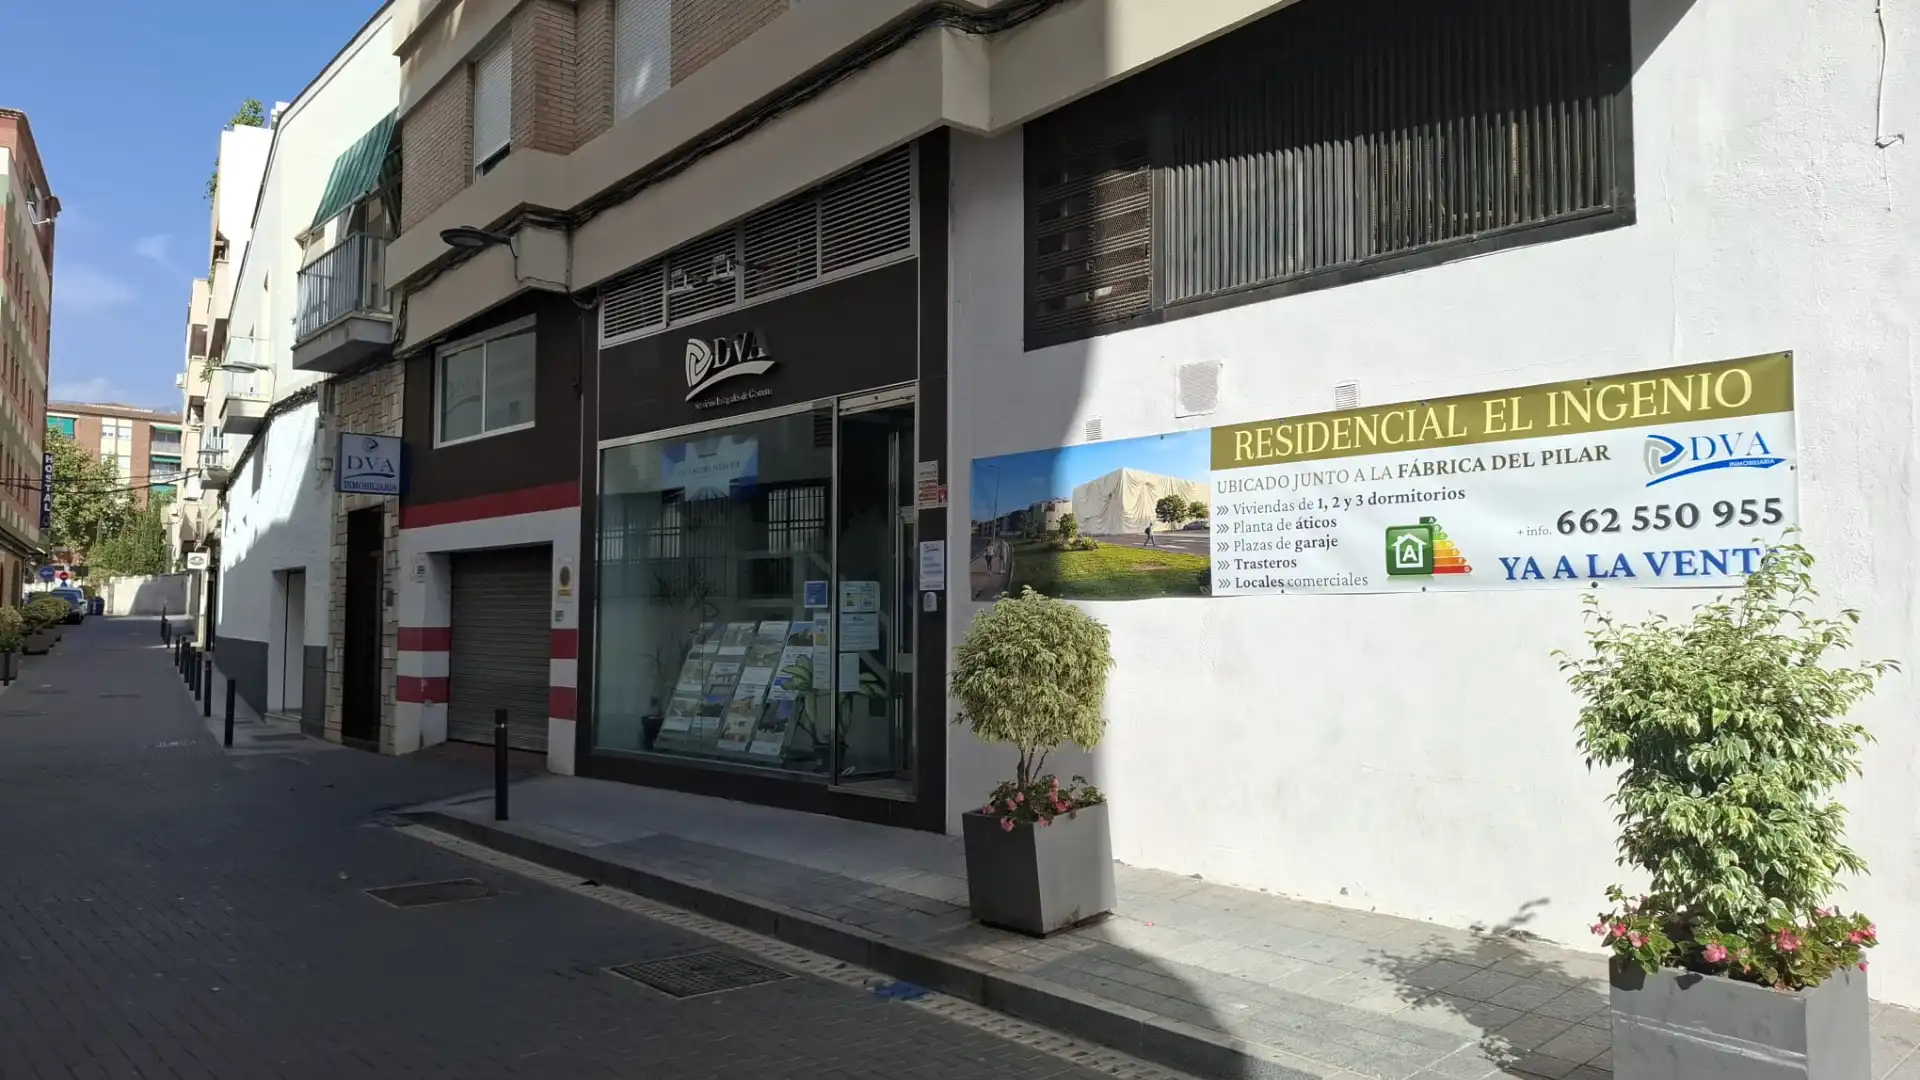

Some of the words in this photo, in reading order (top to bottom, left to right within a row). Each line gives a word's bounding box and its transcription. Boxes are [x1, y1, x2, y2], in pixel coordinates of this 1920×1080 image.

[711, 331, 769, 369] DVA
[1234, 404, 1467, 461] RESIDENCIAL
[1483, 396, 1533, 435] EL
[1546, 368, 1752, 428] INGENIO
[1688, 431, 1773, 460] DVA
[347, 455, 396, 473] DVA
[1217, 474, 1290, 495] UBICADO
[1292, 469, 1349, 492] JUNTO
[1353, 467, 1366, 483] A
[1371, 464, 1393, 481] LA
[1398, 457, 1486, 479] FÁBRICA
[1491, 452, 1536, 471] DEL
[1542, 444, 1611, 466] PILAR
[1729, 458, 1775, 467] INMOBILIARIA
[43, 454, 53, 512] HOSTAL
[1233, 499, 1295, 516] Viviendas
[1298, 496, 1314, 511] de
[1318, 496, 1328, 512] 1,
[1332, 496, 1341, 509] 2
[1343, 497, 1352, 512] y
[1355, 495, 1364, 507] 3
[1368, 487, 1466, 506] dormitorios
[1233, 519, 1274, 534] Planta
[1276, 517, 1292, 531] de
[1295, 516, 1337, 531] áticos
[1556, 507, 1621, 536] 662
[1631, 502, 1700, 532] 550
[1712, 497, 1784, 528] 955
[1233, 537, 1274, 552] Plazas
[1276, 536, 1292, 550] de
[1294, 534, 1339, 554] garaje
[1402, 544, 1418, 562] A
[1234, 558, 1297, 570] Trasteros
[1498, 556, 1545, 581] YA
[1552, 555, 1577, 580] A
[1586, 552, 1636, 578] LA
[1235, 576, 1285, 589] Locales
[1287, 573, 1369, 589] comerciales
